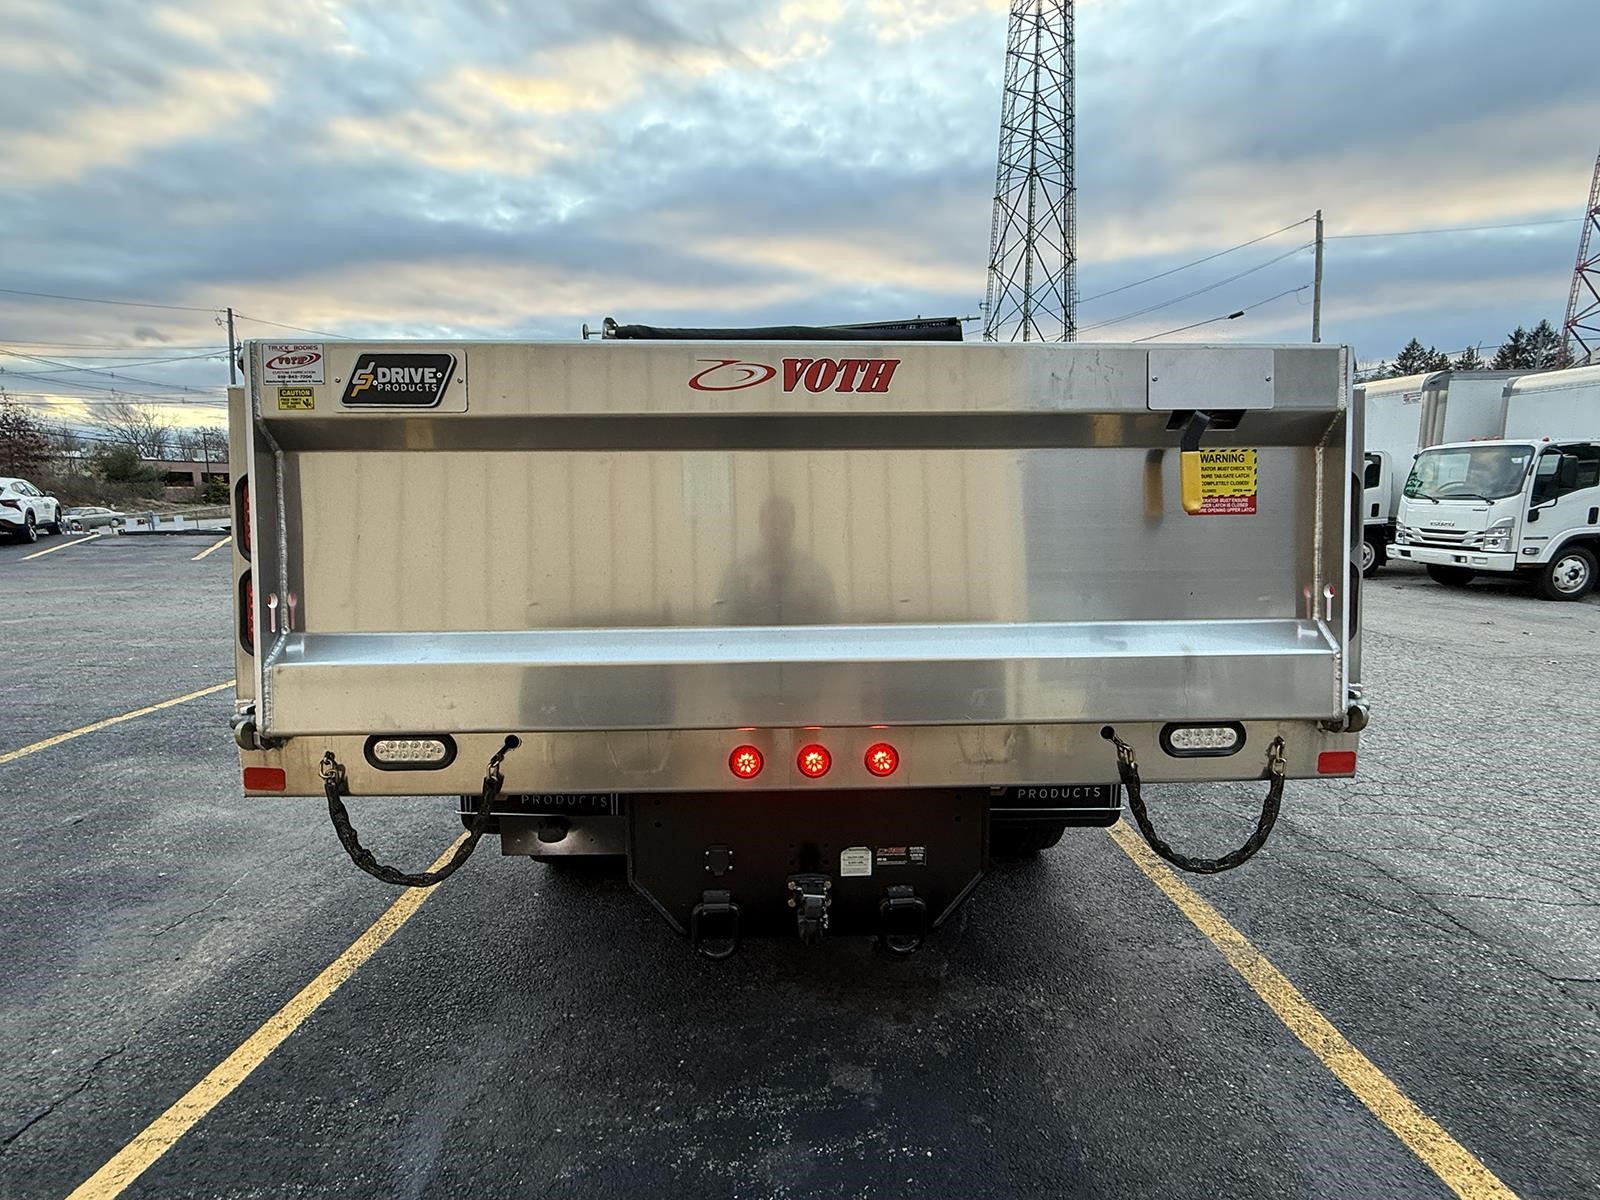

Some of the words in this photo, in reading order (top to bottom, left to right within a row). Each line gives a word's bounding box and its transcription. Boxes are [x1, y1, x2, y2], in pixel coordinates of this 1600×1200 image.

[377, 367, 437, 383] DRIVE
[782, 358, 901, 393] VOTH
[281, 389, 311, 397] CAUTION
[377, 383, 437, 392] PRODUCTS
[1200, 454, 1245, 463] WARNING
[1018, 786, 1101, 799] PRODUCTS
